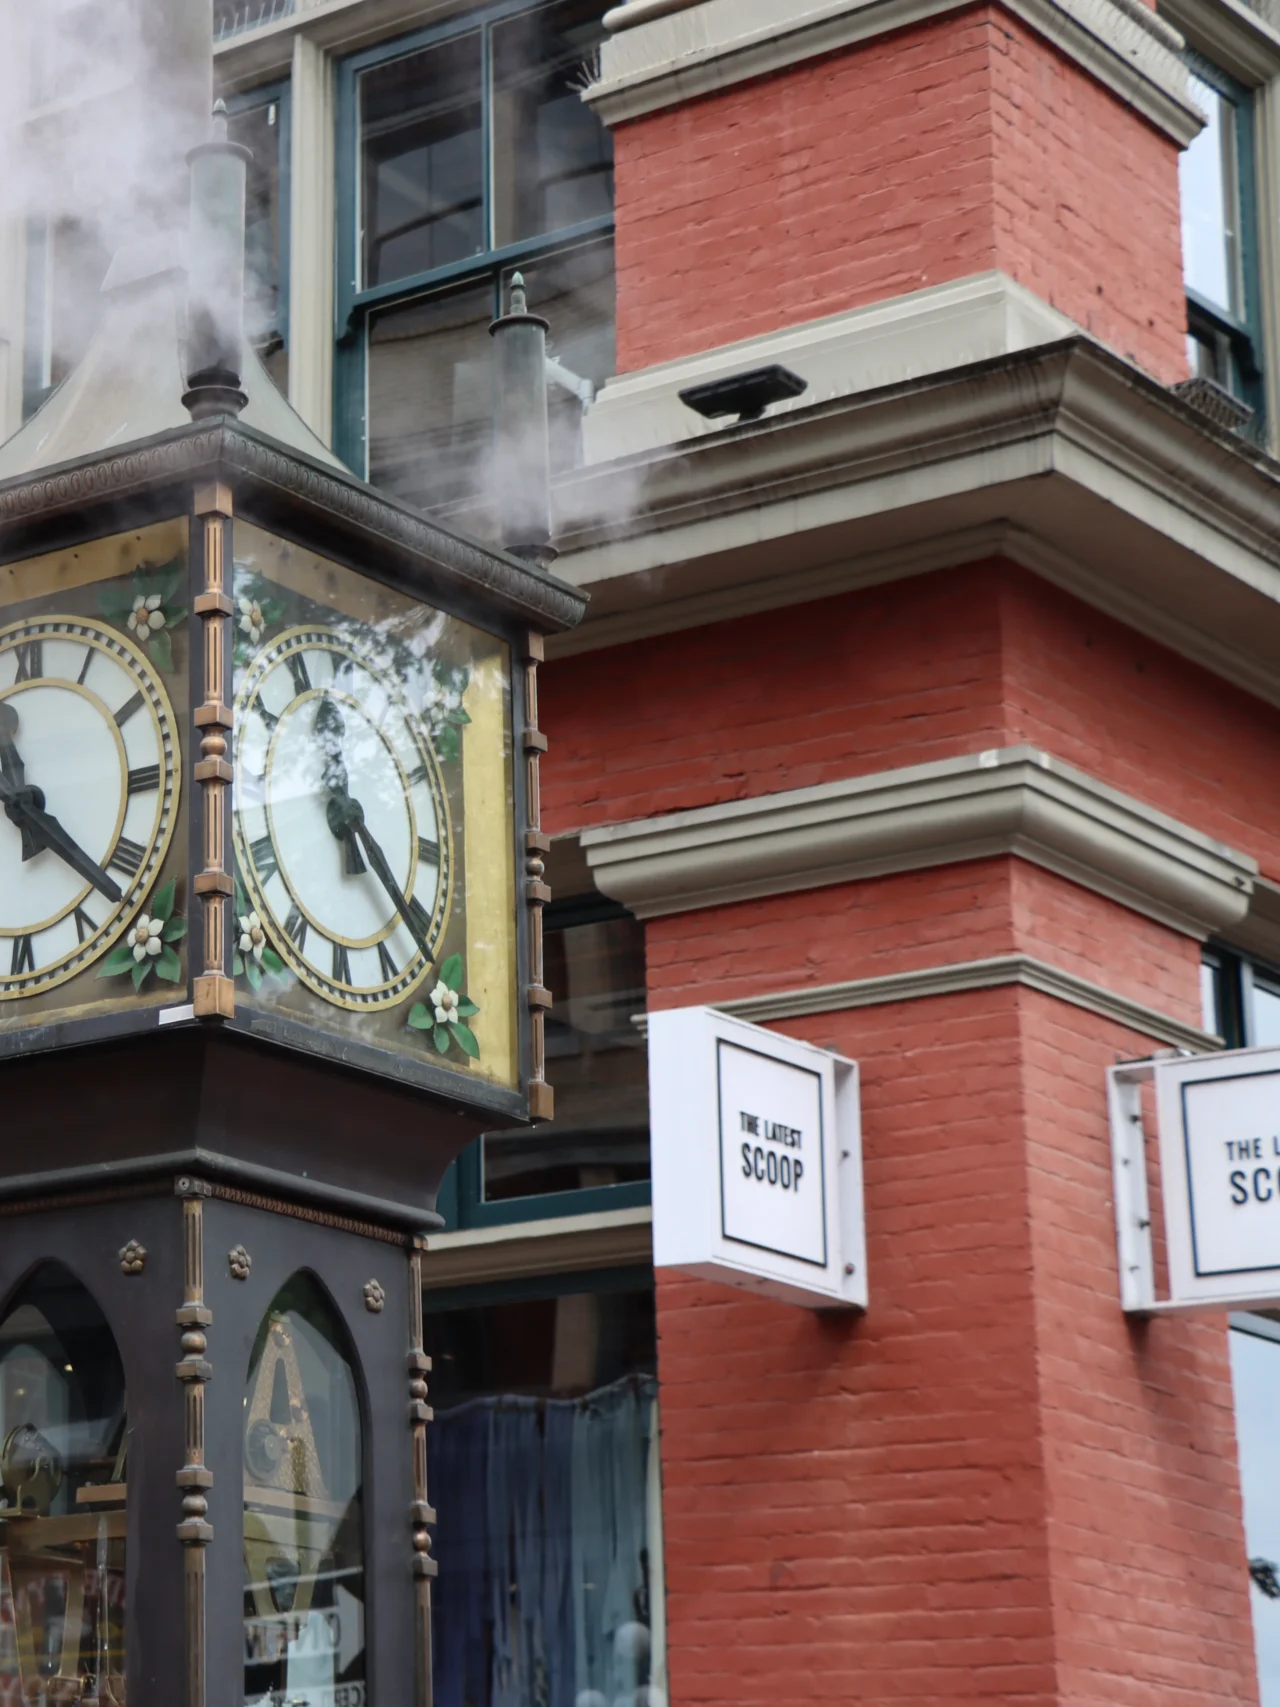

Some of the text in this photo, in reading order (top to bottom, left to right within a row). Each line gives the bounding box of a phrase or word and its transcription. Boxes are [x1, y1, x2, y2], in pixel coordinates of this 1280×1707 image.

[738, 1111, 802, 1150] THE LATEST
[1224, 1137, 1263, 1162] THE
[741, 1141, 804, 1193] SCOOP
[1229, 1167, 1280, 1206] SC
